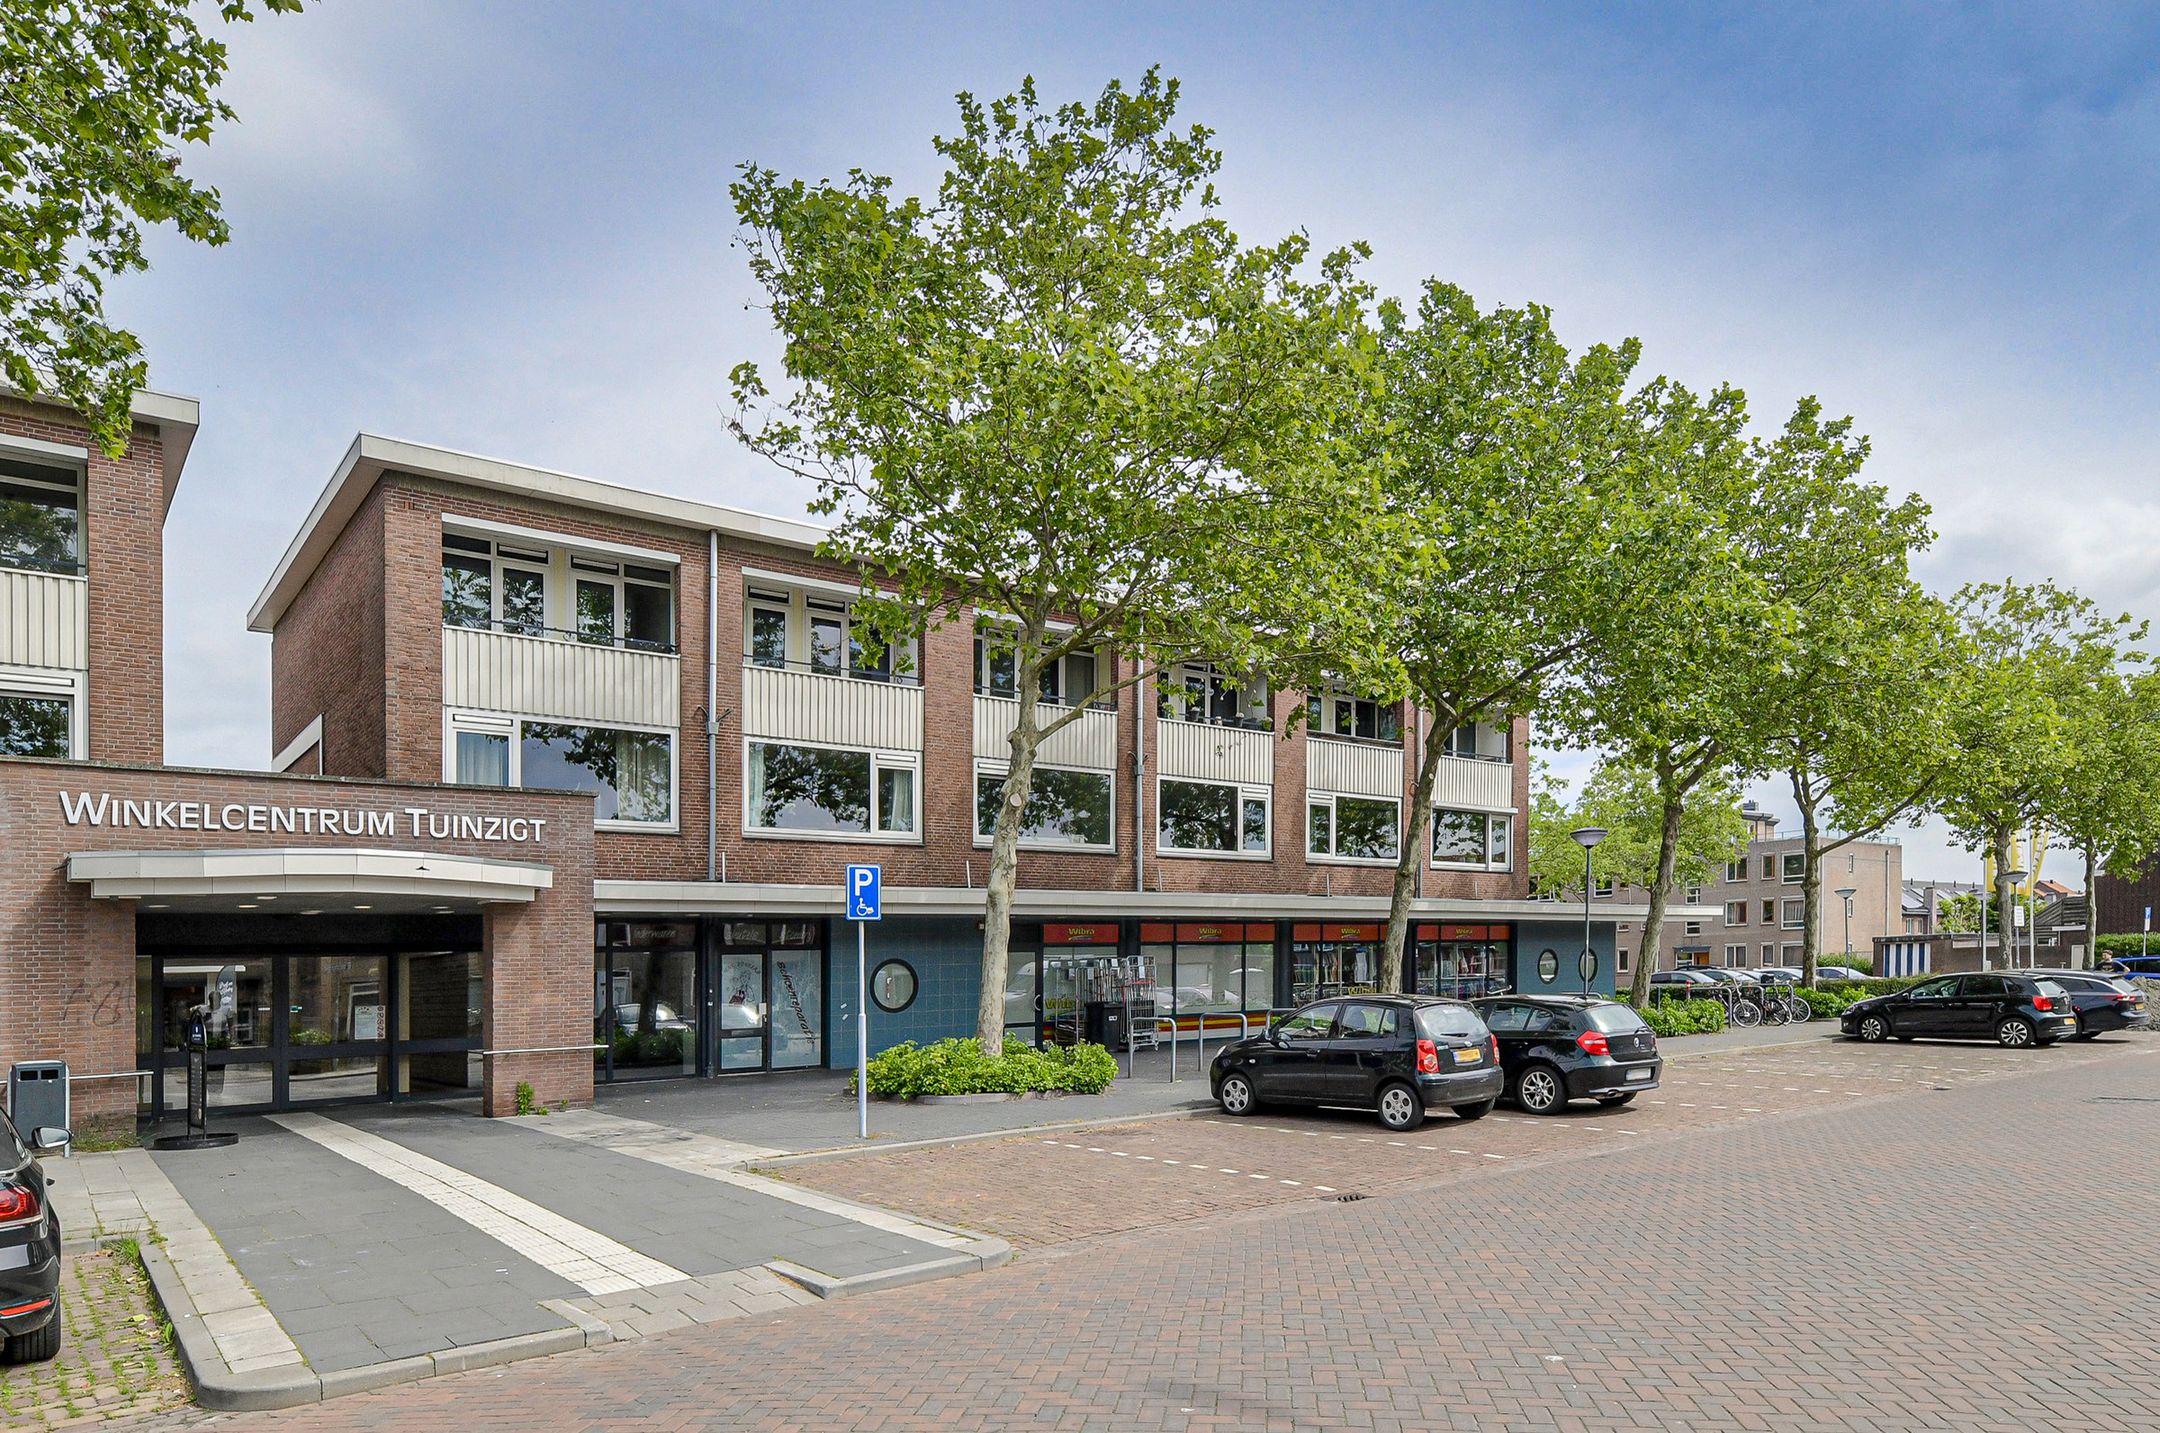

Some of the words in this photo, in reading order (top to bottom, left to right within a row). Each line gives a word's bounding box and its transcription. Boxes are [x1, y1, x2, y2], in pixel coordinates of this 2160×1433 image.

[59, 790, 395, 836] WINKELCENTRUM
[404, 807, 547, 842] TUINZIGT
[854, 869, 873, 896] P
[1068, 927, 1095, 935] Wibra
